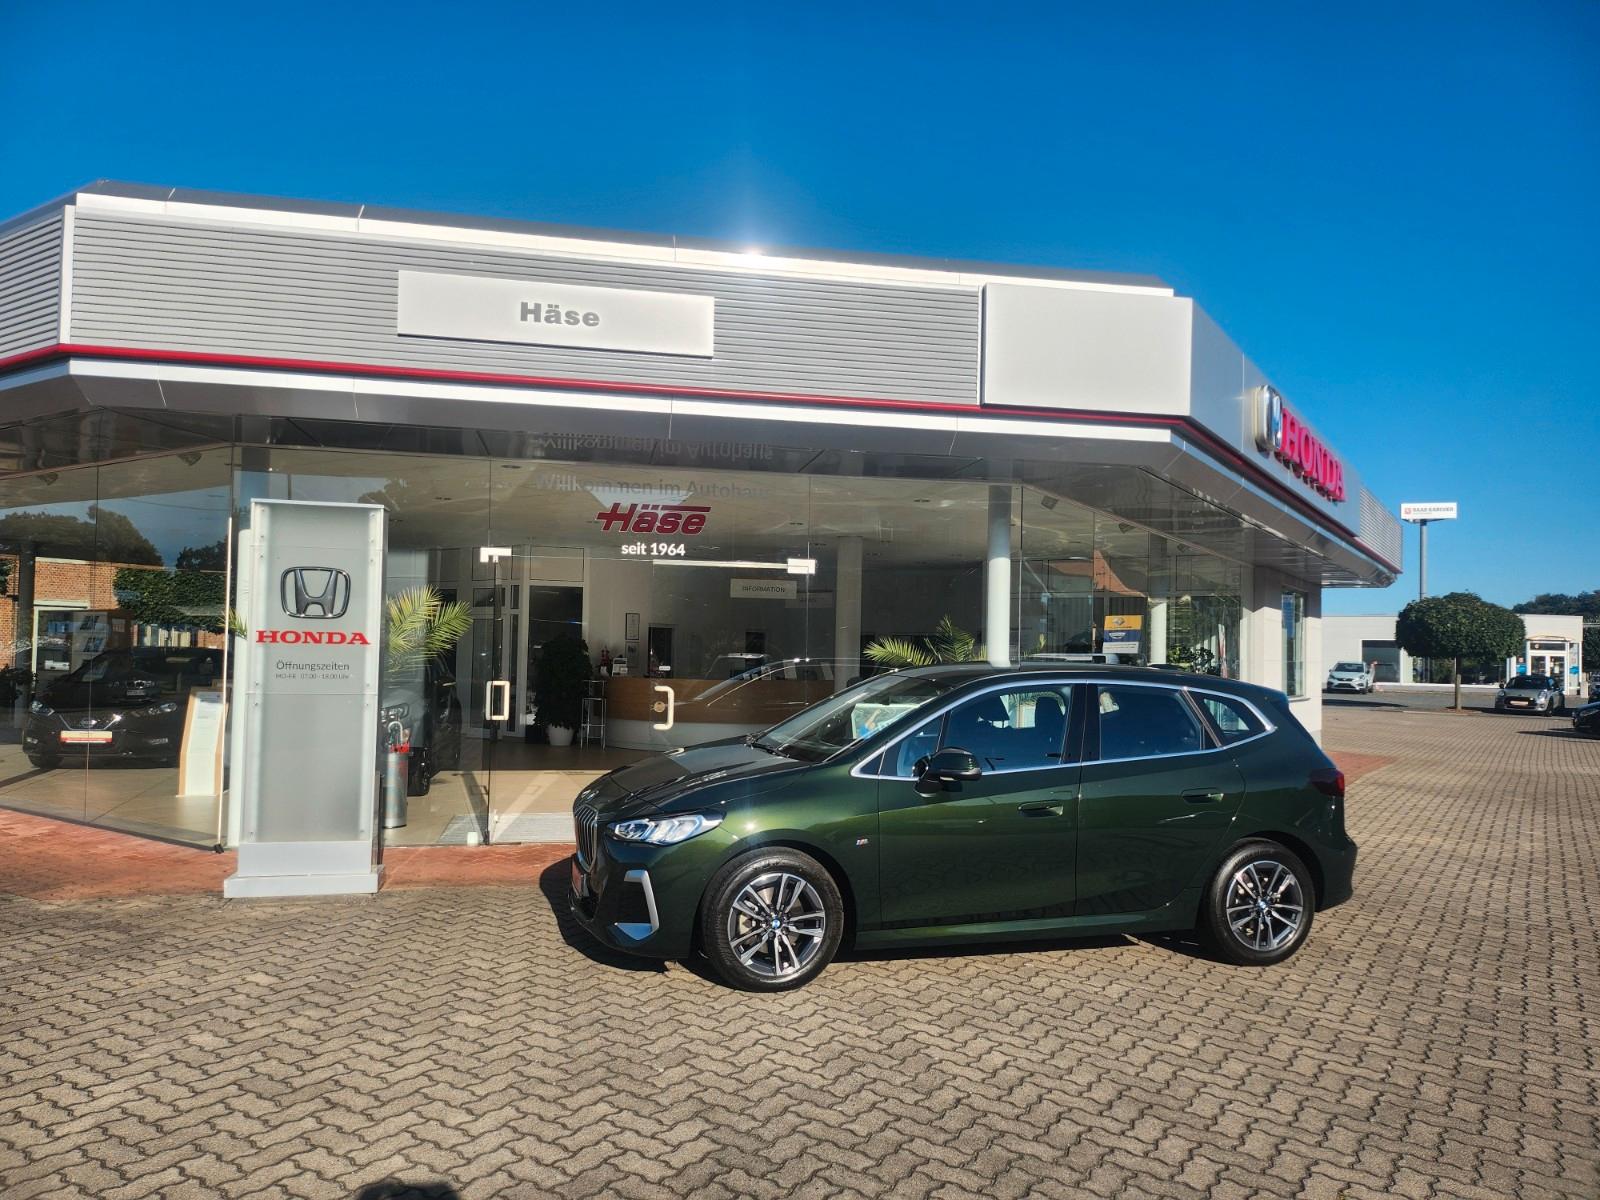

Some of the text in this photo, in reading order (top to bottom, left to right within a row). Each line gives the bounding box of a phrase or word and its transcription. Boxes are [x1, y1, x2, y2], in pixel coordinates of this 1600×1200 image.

[520, 301, 600, 327] Häse
[1280, 407, 1346, 502] HONDA
[658, 479, 681, 496] im
[595, 502, 712, 535] Häse
[621, 542, 686, 557] seit 1964
[256, 630, 371, 645] HONDA
[276, 660, 350, 671] Öffnungszeiten
